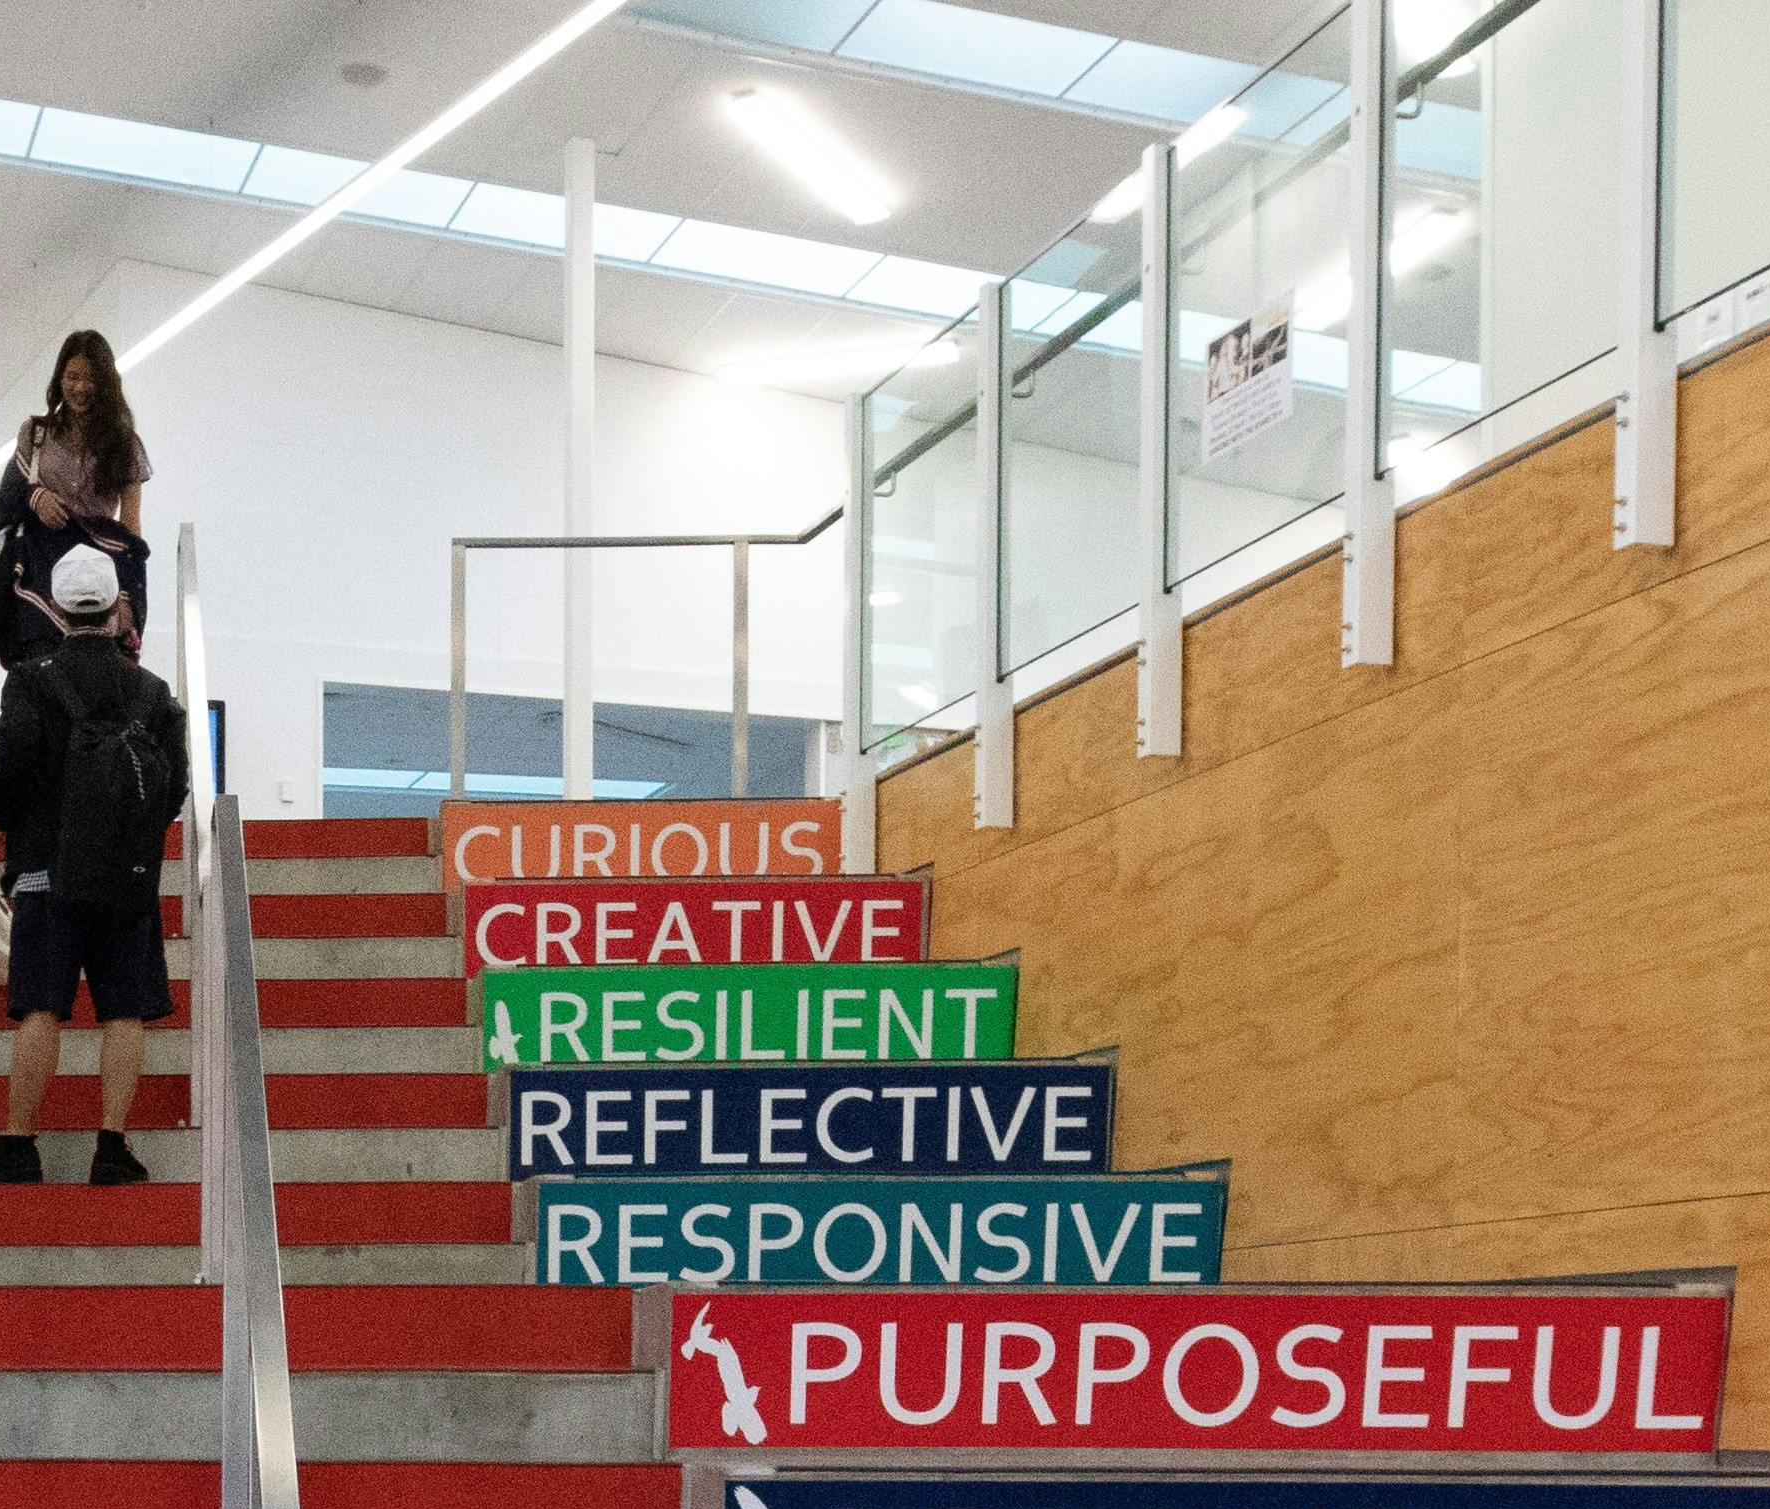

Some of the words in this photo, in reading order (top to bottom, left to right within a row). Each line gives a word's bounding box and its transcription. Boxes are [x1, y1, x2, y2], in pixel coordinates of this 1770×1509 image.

[454, 821, 823, 880] CURIOUS
[477, 900, 903, 965] CREATIVE
[540, 989, 997, 1062] RESILIENT
[521, 1086, 1092, 1166] REFLECTIVE
[547, 1203, 1203, 1284] RESPONSIVE
[789, 1322, 1703, 1430] PURPOSEFUL
